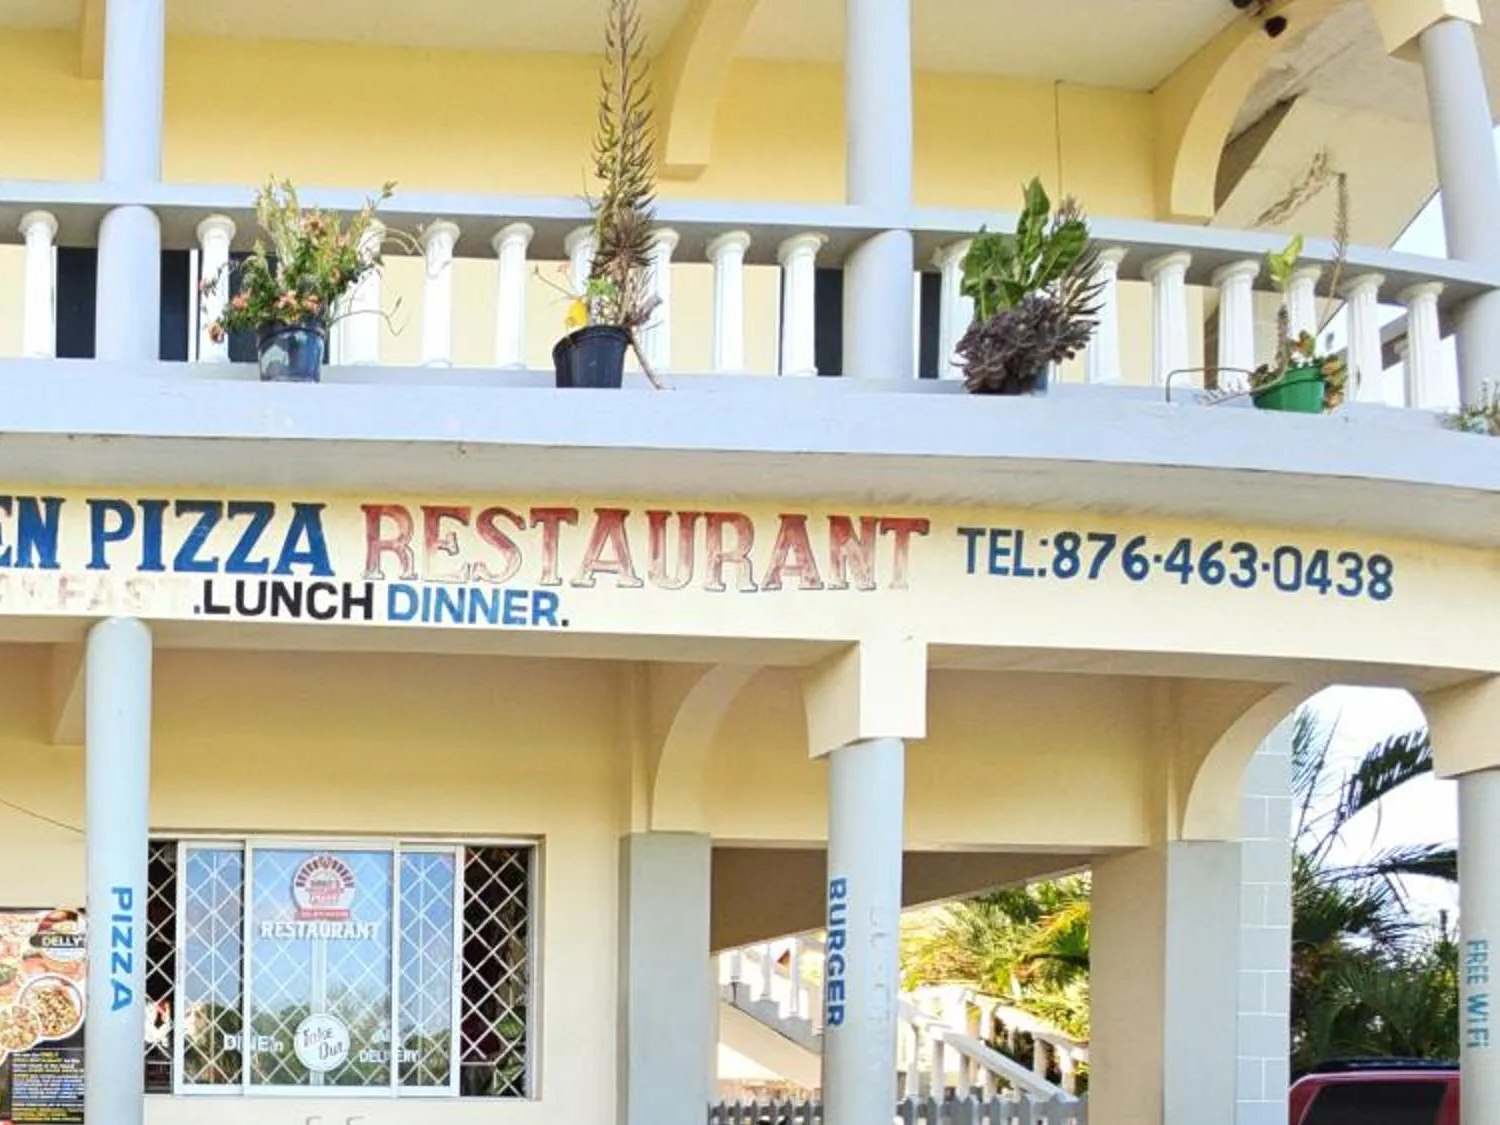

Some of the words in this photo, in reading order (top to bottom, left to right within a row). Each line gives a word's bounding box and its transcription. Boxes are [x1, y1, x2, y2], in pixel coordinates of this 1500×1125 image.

[86, 499, 334, 577] PIZZA
[361, 503, 931, 593] RESTAURANT
[111, 887, 133, 1012] PIZZA
[260, 921, 381, 940] RESTAURANT
[828, 878, 847, 1026] BURGER
[1466, 940, 1489, 985] FREE
[360, 1049, 419, 1062] DELIERY
